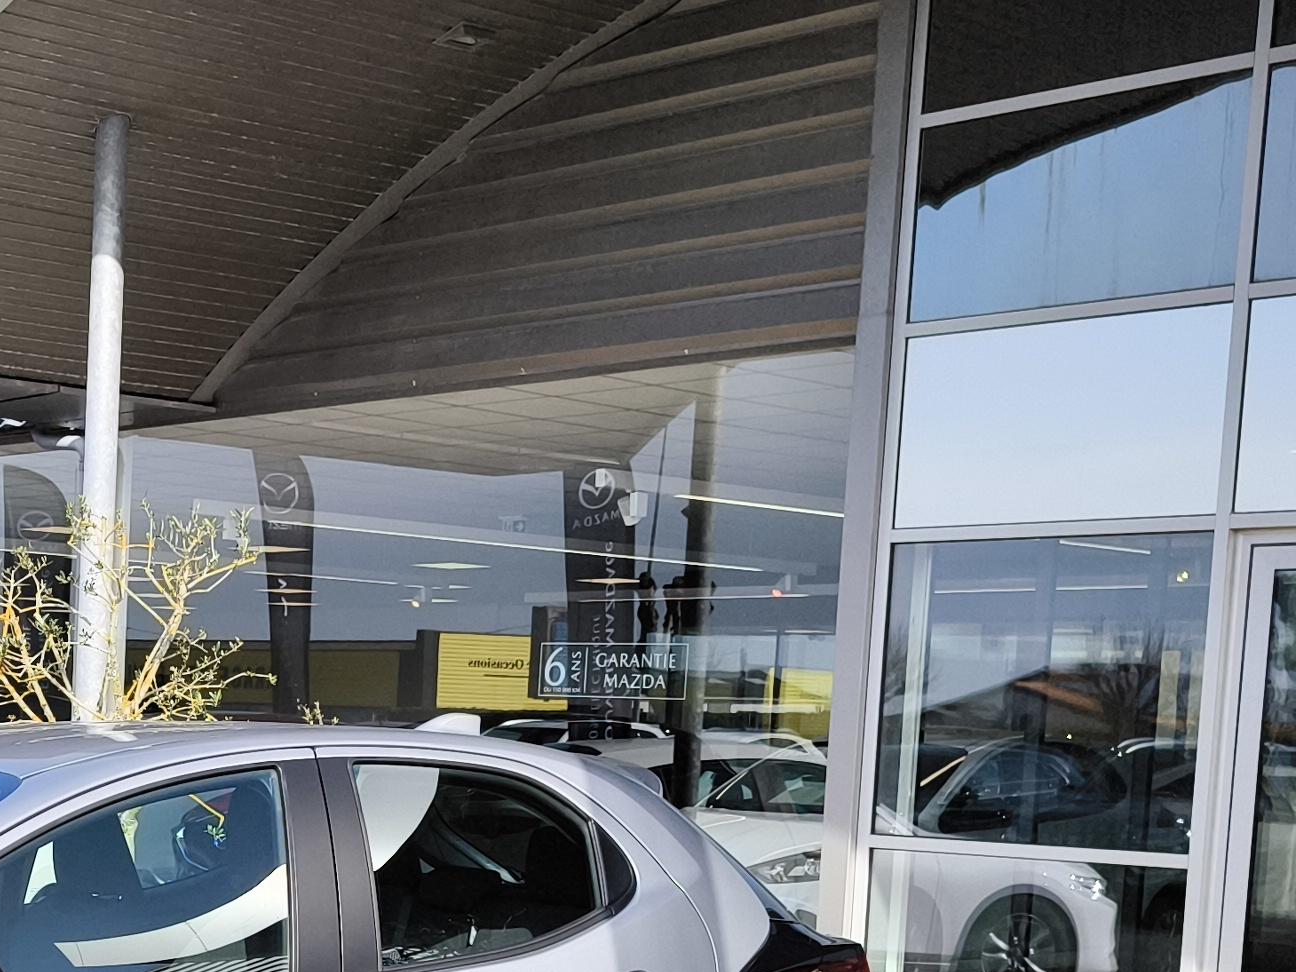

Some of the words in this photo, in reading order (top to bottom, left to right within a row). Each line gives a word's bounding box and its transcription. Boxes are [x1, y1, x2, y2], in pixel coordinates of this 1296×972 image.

[544, 646, 566, 687] 6
[570, 651, 582, 683] ANS
[595, 652, 677, 669] GARANTIE
[602, 673, 667, 690] MAZDA
